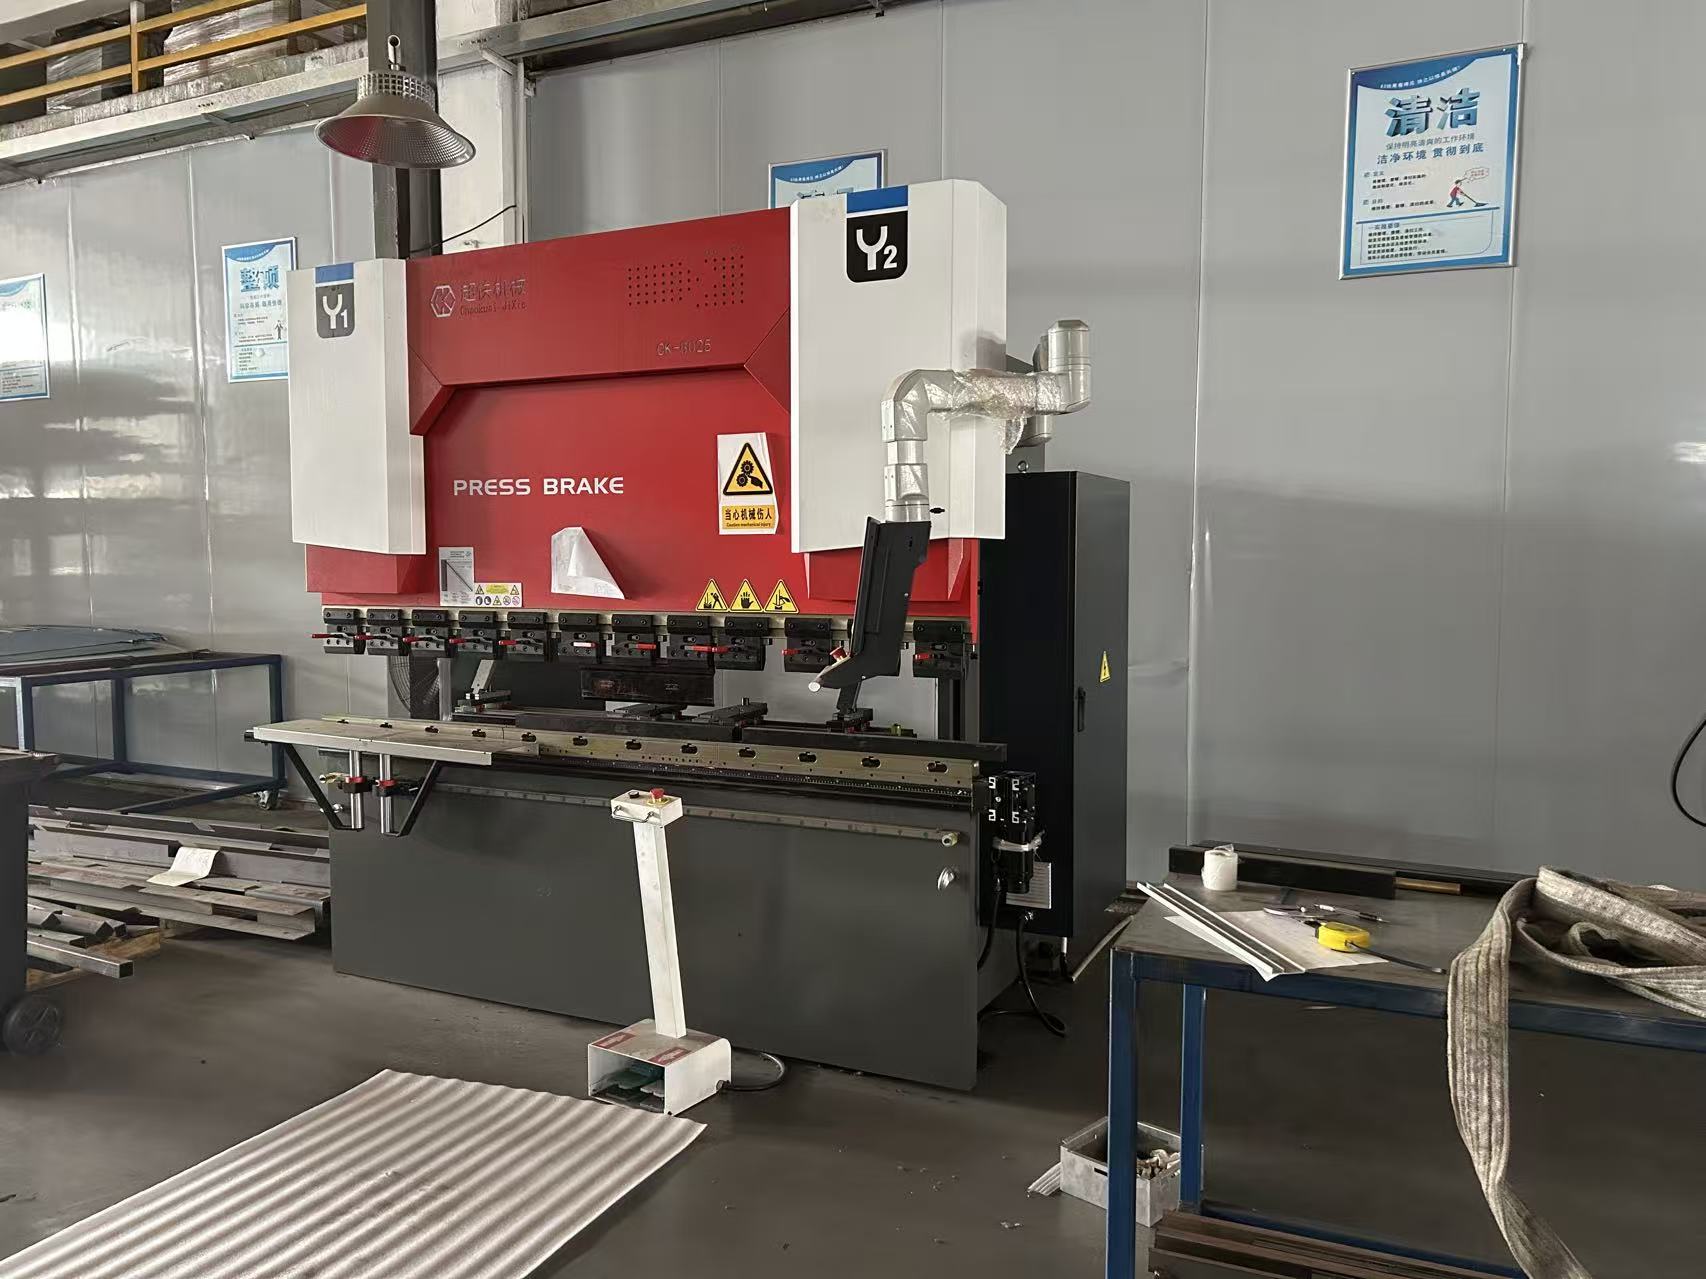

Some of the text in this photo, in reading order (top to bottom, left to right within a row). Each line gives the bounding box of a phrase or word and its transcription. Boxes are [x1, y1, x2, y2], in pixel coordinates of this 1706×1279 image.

[1384, 87, 1480, 137] 清洁
[1376, 142, 1485, 165] 洁净环境 贯彻到底
[856, 225, 898, 271] Y2
[240, 265, 280, 293] 整顿
[322, 293, 348, 329] Y1
[453, 476, 624, 496] PRESS BRAKE
[725, 507, 773, 521] 当心机械伤人
